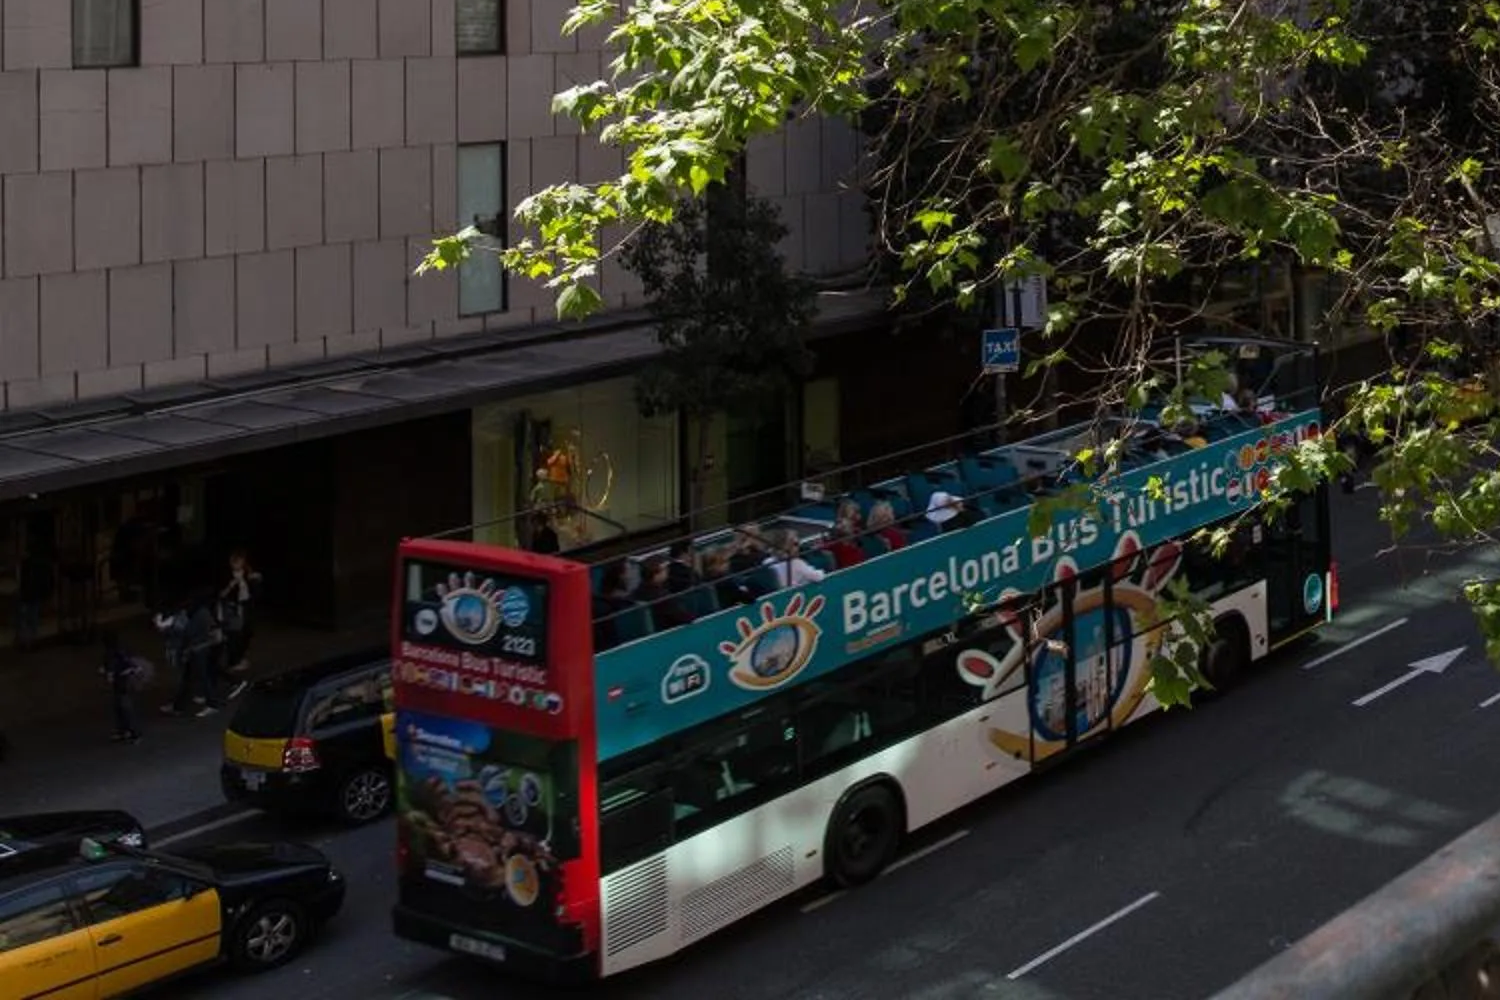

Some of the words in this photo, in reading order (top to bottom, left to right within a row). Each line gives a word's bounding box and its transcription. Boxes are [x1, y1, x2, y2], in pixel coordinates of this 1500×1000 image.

[987, 341, 1017, 353] TAXI
[842, 545, 1020, 635] Barcelona
[1031, 514, 1099, 565] Bus
